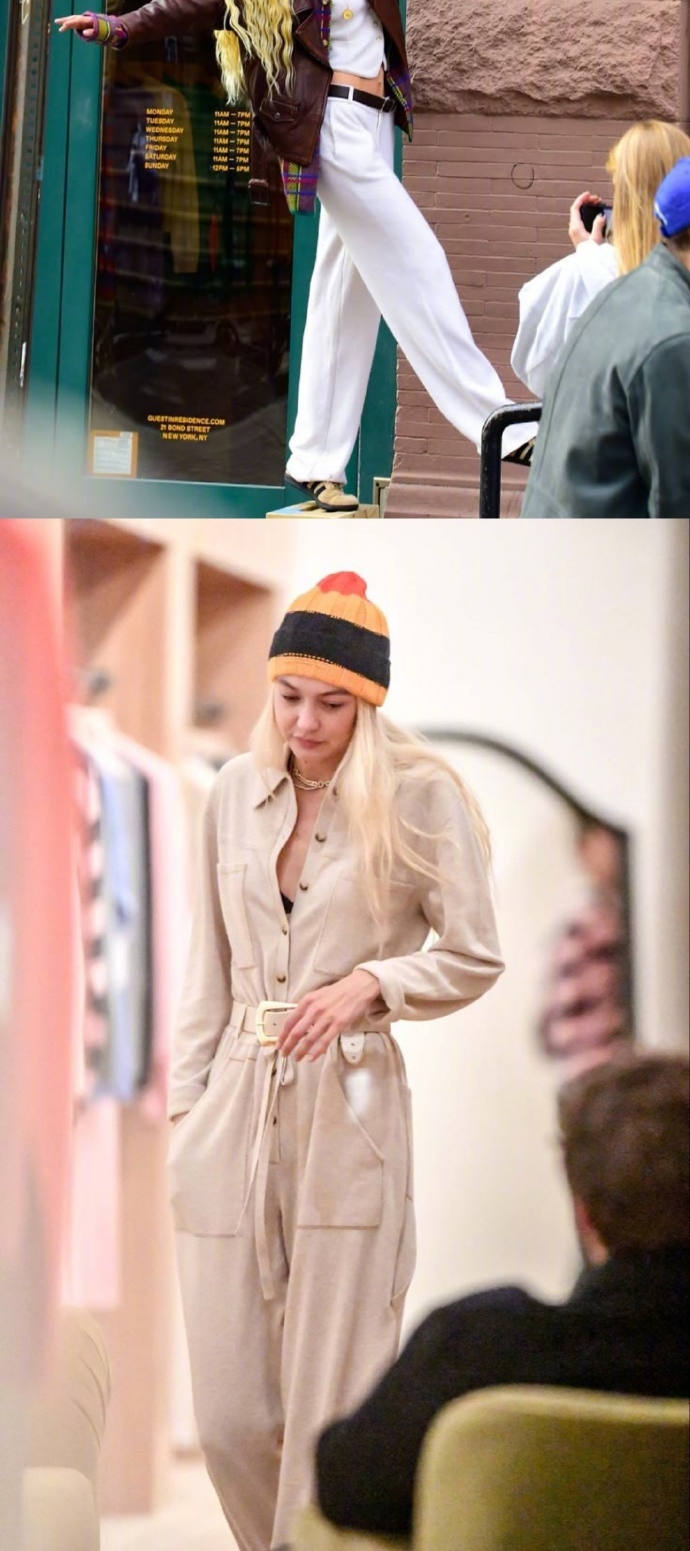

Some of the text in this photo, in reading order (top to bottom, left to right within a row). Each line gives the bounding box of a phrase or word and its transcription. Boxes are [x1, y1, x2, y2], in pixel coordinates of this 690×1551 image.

[145, 152, 177, 160] SATURDAY
[144, 161, 169, 169] SUNDAY
[147, 415, 226, 425] GUESTINRESIDENCE.COM
[186, 425, 211, 433] STREET
